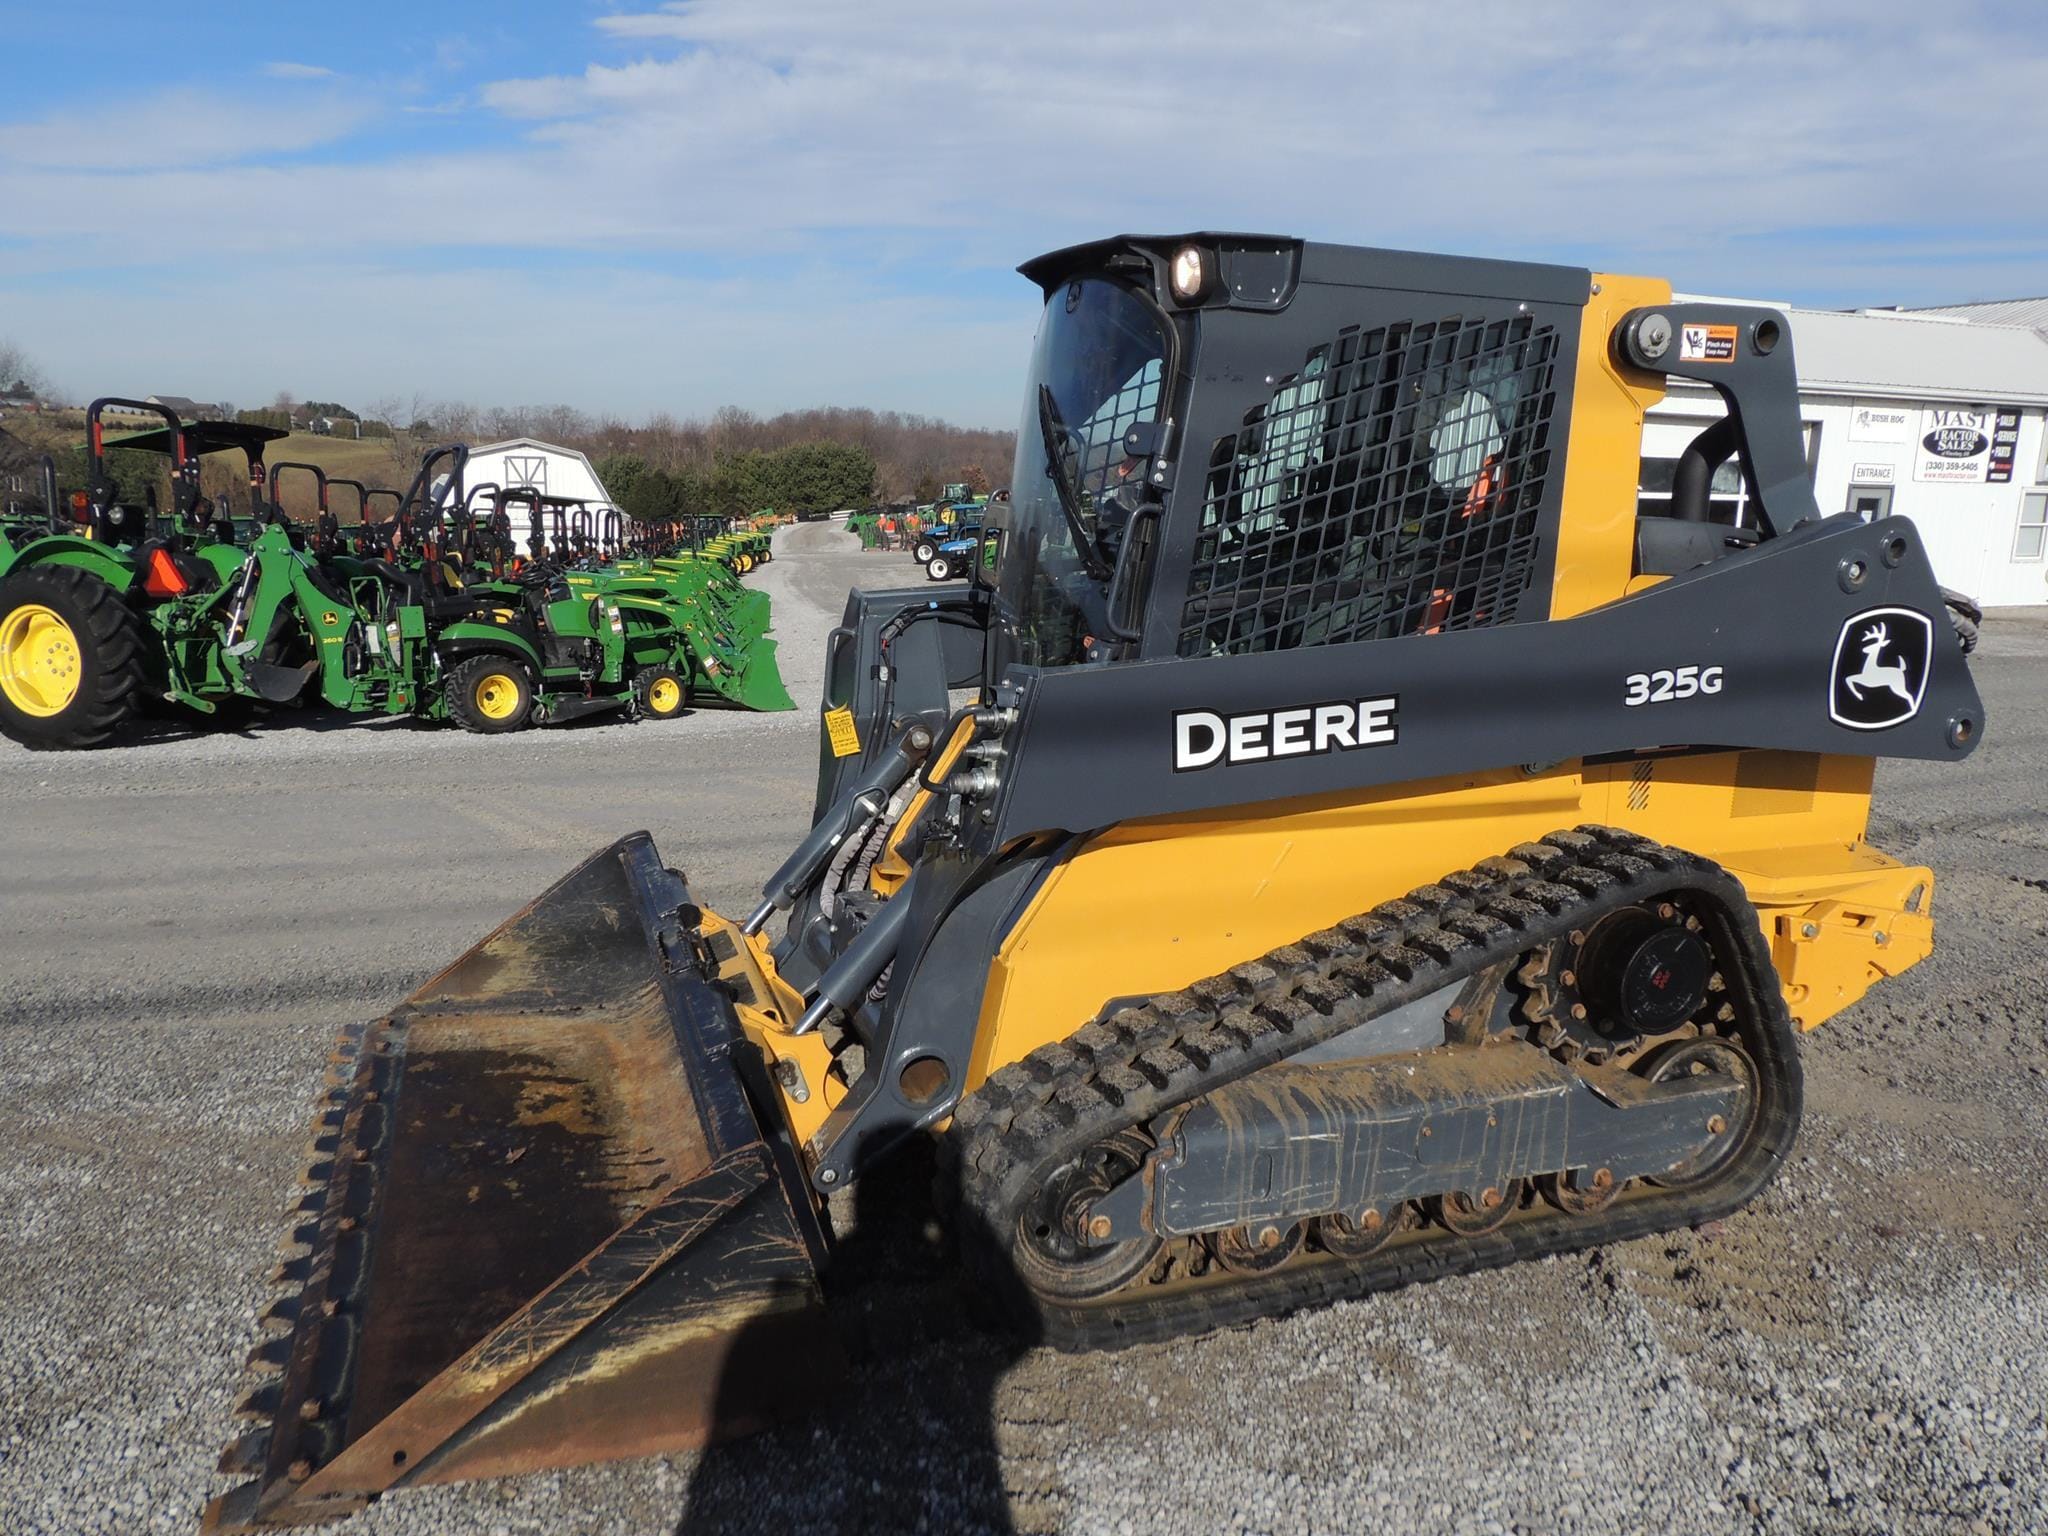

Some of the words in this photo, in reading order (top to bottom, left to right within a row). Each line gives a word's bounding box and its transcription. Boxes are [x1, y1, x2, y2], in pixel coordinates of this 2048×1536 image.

[1931, 410, 1989, 430] MAST
[1934, 429, 1979, 442] TRACTOR
[1938, 440, 1975, 451] SALES
[1925, 461, 1945, 471] (330)
[1857, 468, 1891, 478] ENTRANCE
[1625, 666, 1723, 706] 325G
[1176, 699, 1395, 769] DEERE
